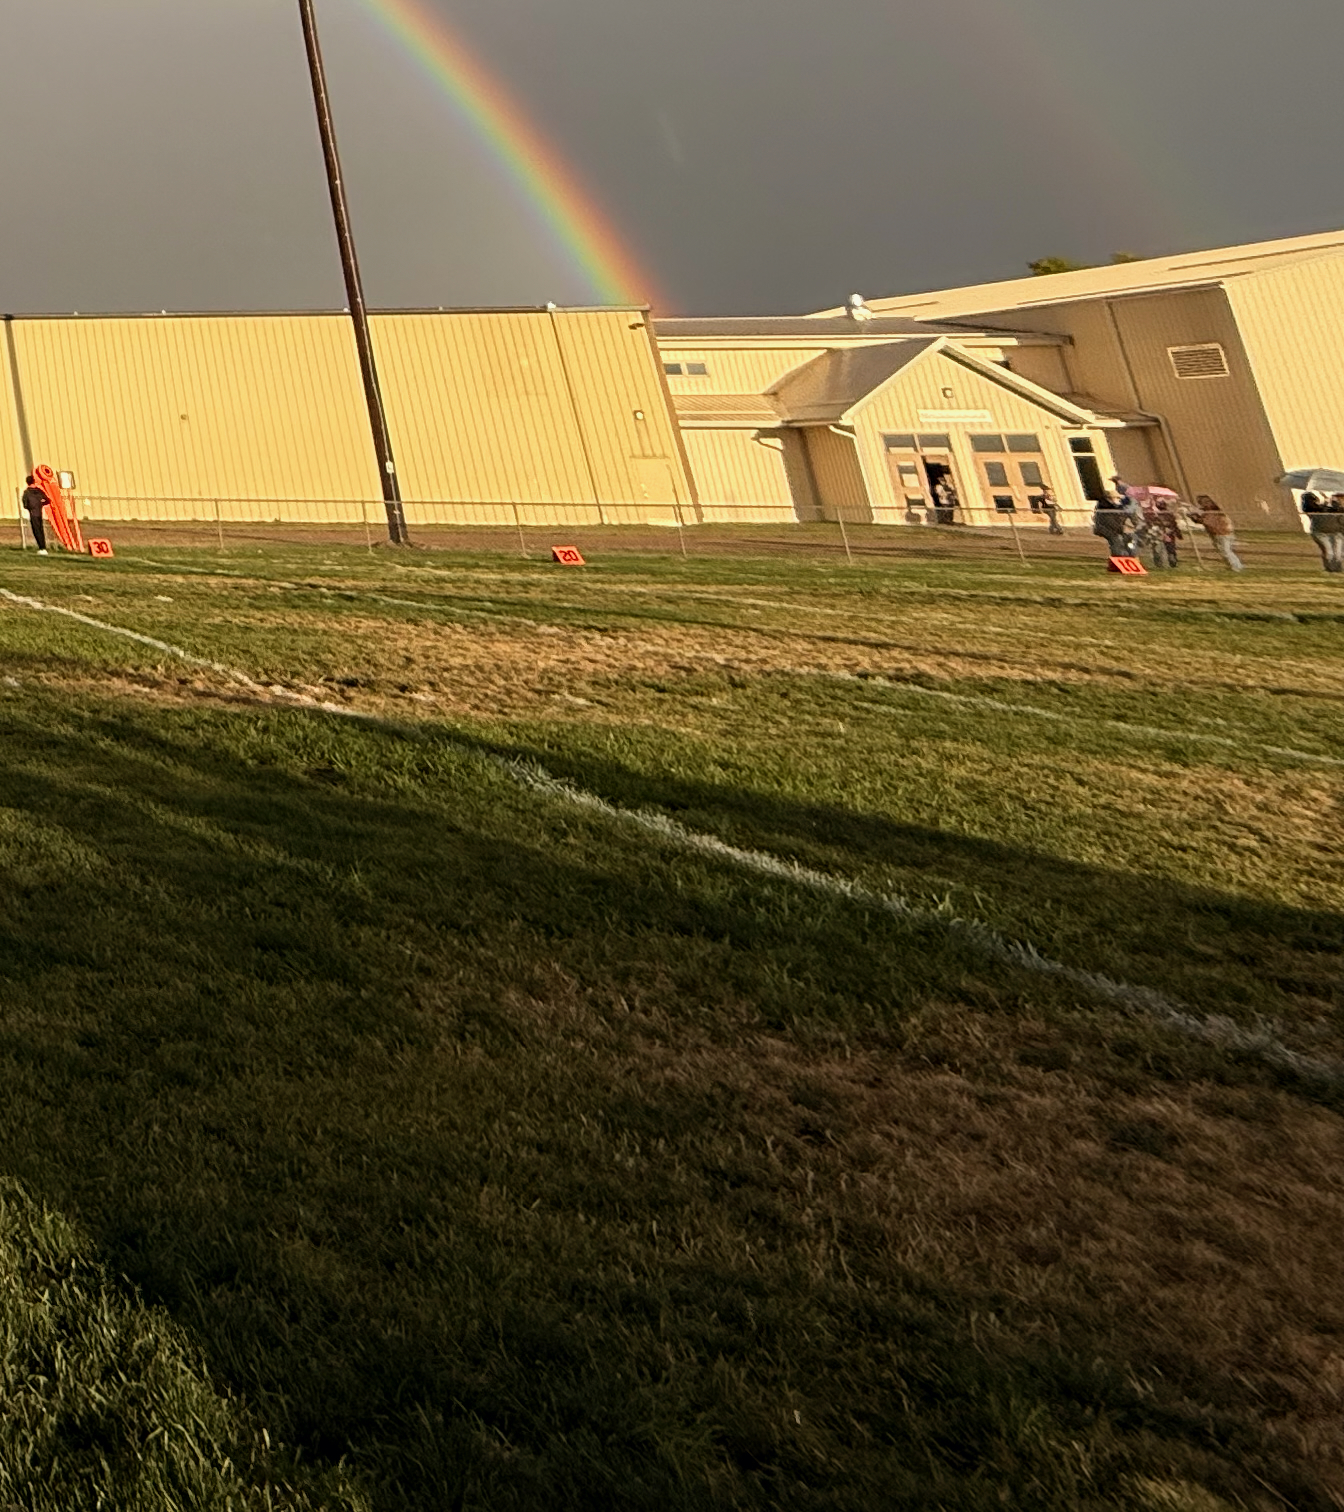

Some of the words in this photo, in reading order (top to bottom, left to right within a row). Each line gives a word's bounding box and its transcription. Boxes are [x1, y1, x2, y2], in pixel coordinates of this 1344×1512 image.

[92, 541, 110, 554] 30
[558, 549, 580, 562] 20
[1117, 558, 1141, 573] 10
